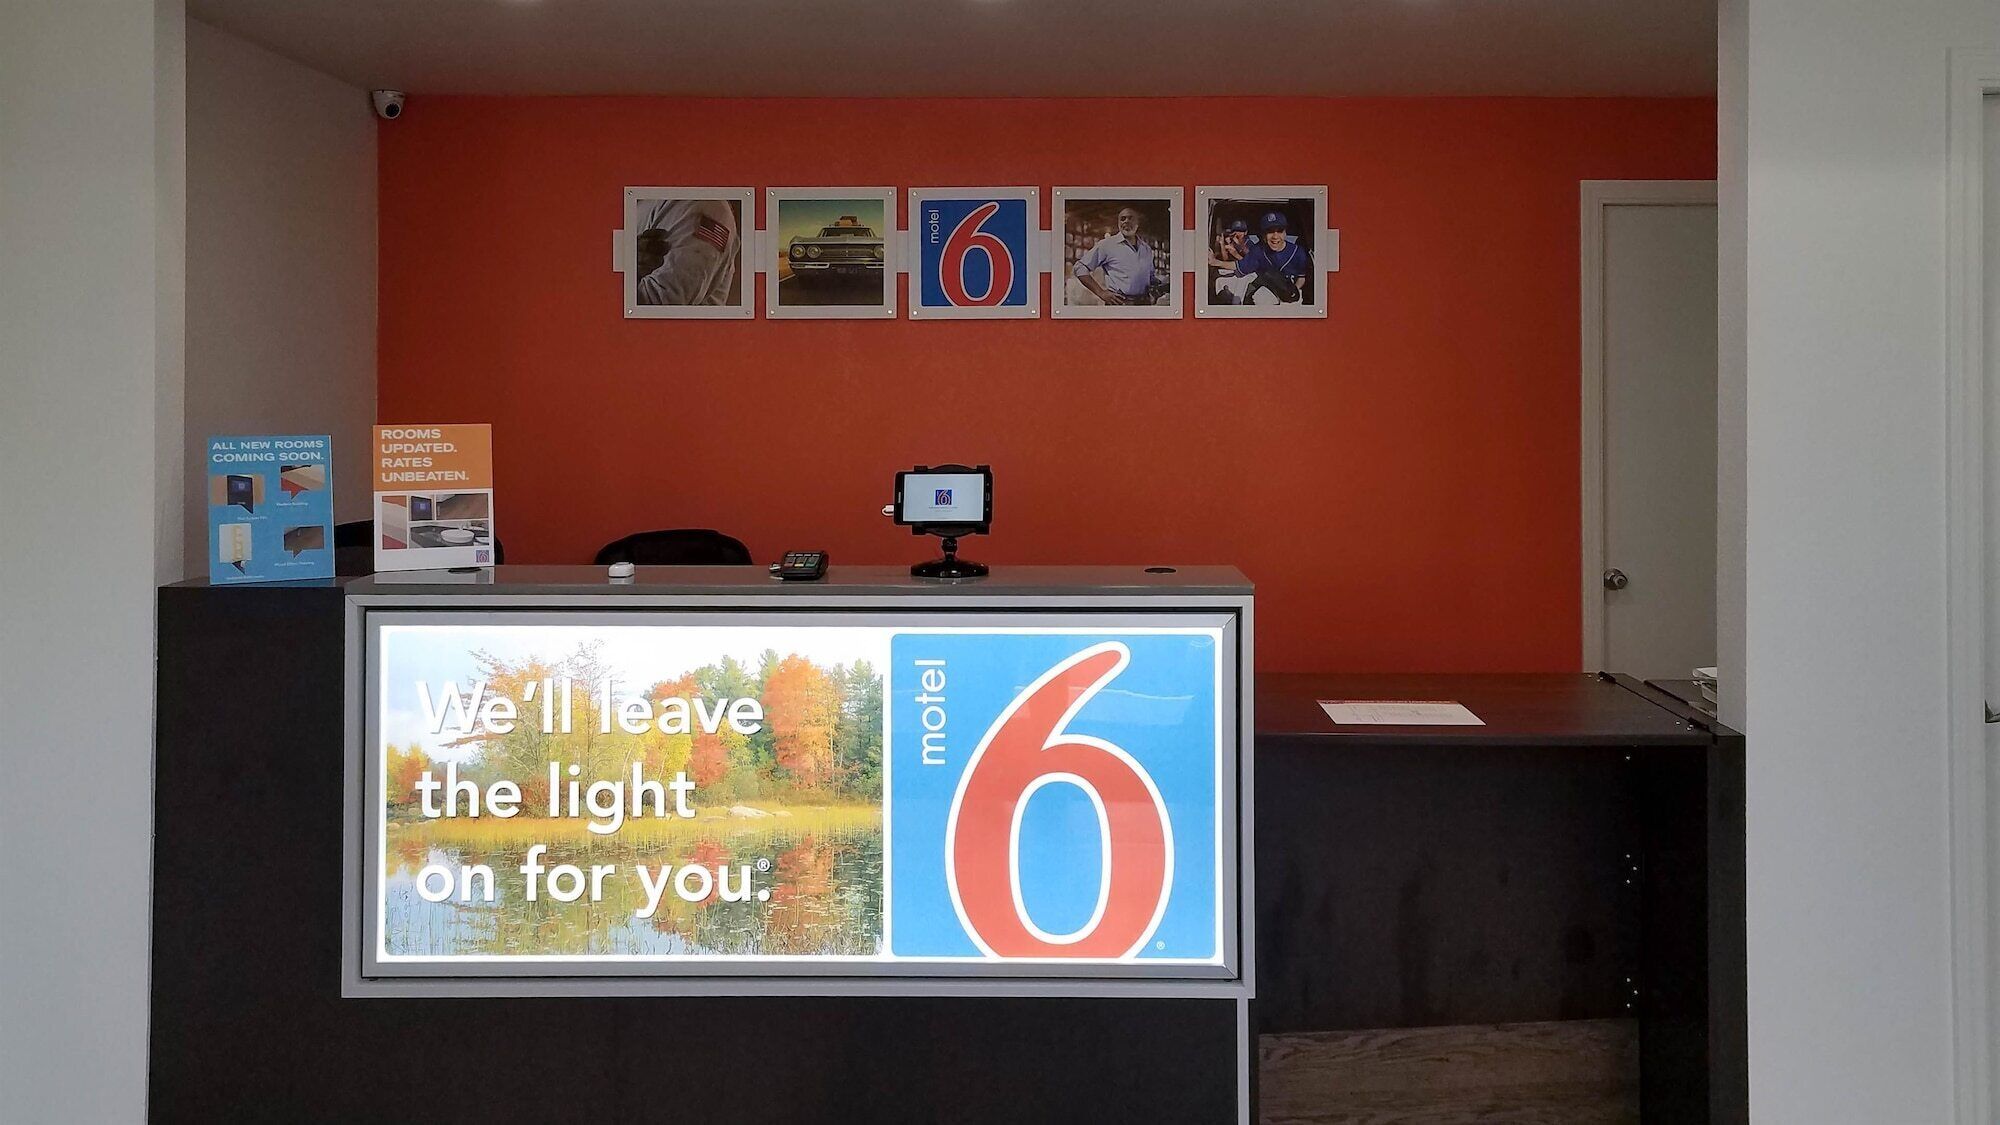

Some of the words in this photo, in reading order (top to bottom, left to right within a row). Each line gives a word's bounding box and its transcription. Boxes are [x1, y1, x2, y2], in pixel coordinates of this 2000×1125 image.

[928, 209, 940, 244] motel
[939, 201, 1015, 307] 6
[381, 429, 441, 440] ROOMS
[212, 442, 236, 450] ALL
[240, 441, 271, 449] NEW
[274, 440, 324, 449] ROOMS
[381, 442, 458, 454] UPDATED.
[212, 452, 275, 462] COMING
[279, 451, 325, 461] SOON.
[381, 457, 433, 468] RATES
[381, 471, 470, 482] UNBEATEN.
[416, 677, 573, 735] We'll
[600, 677, 765, 735] leave
[415, 761, 522, 819] the
[549, 761, 697, 835] light
[914, 659, 946, 765] motel
[945, 640, 1175, 958] 6
[415, 863, 496, 903] on
[520, 845, 616, 903] for
